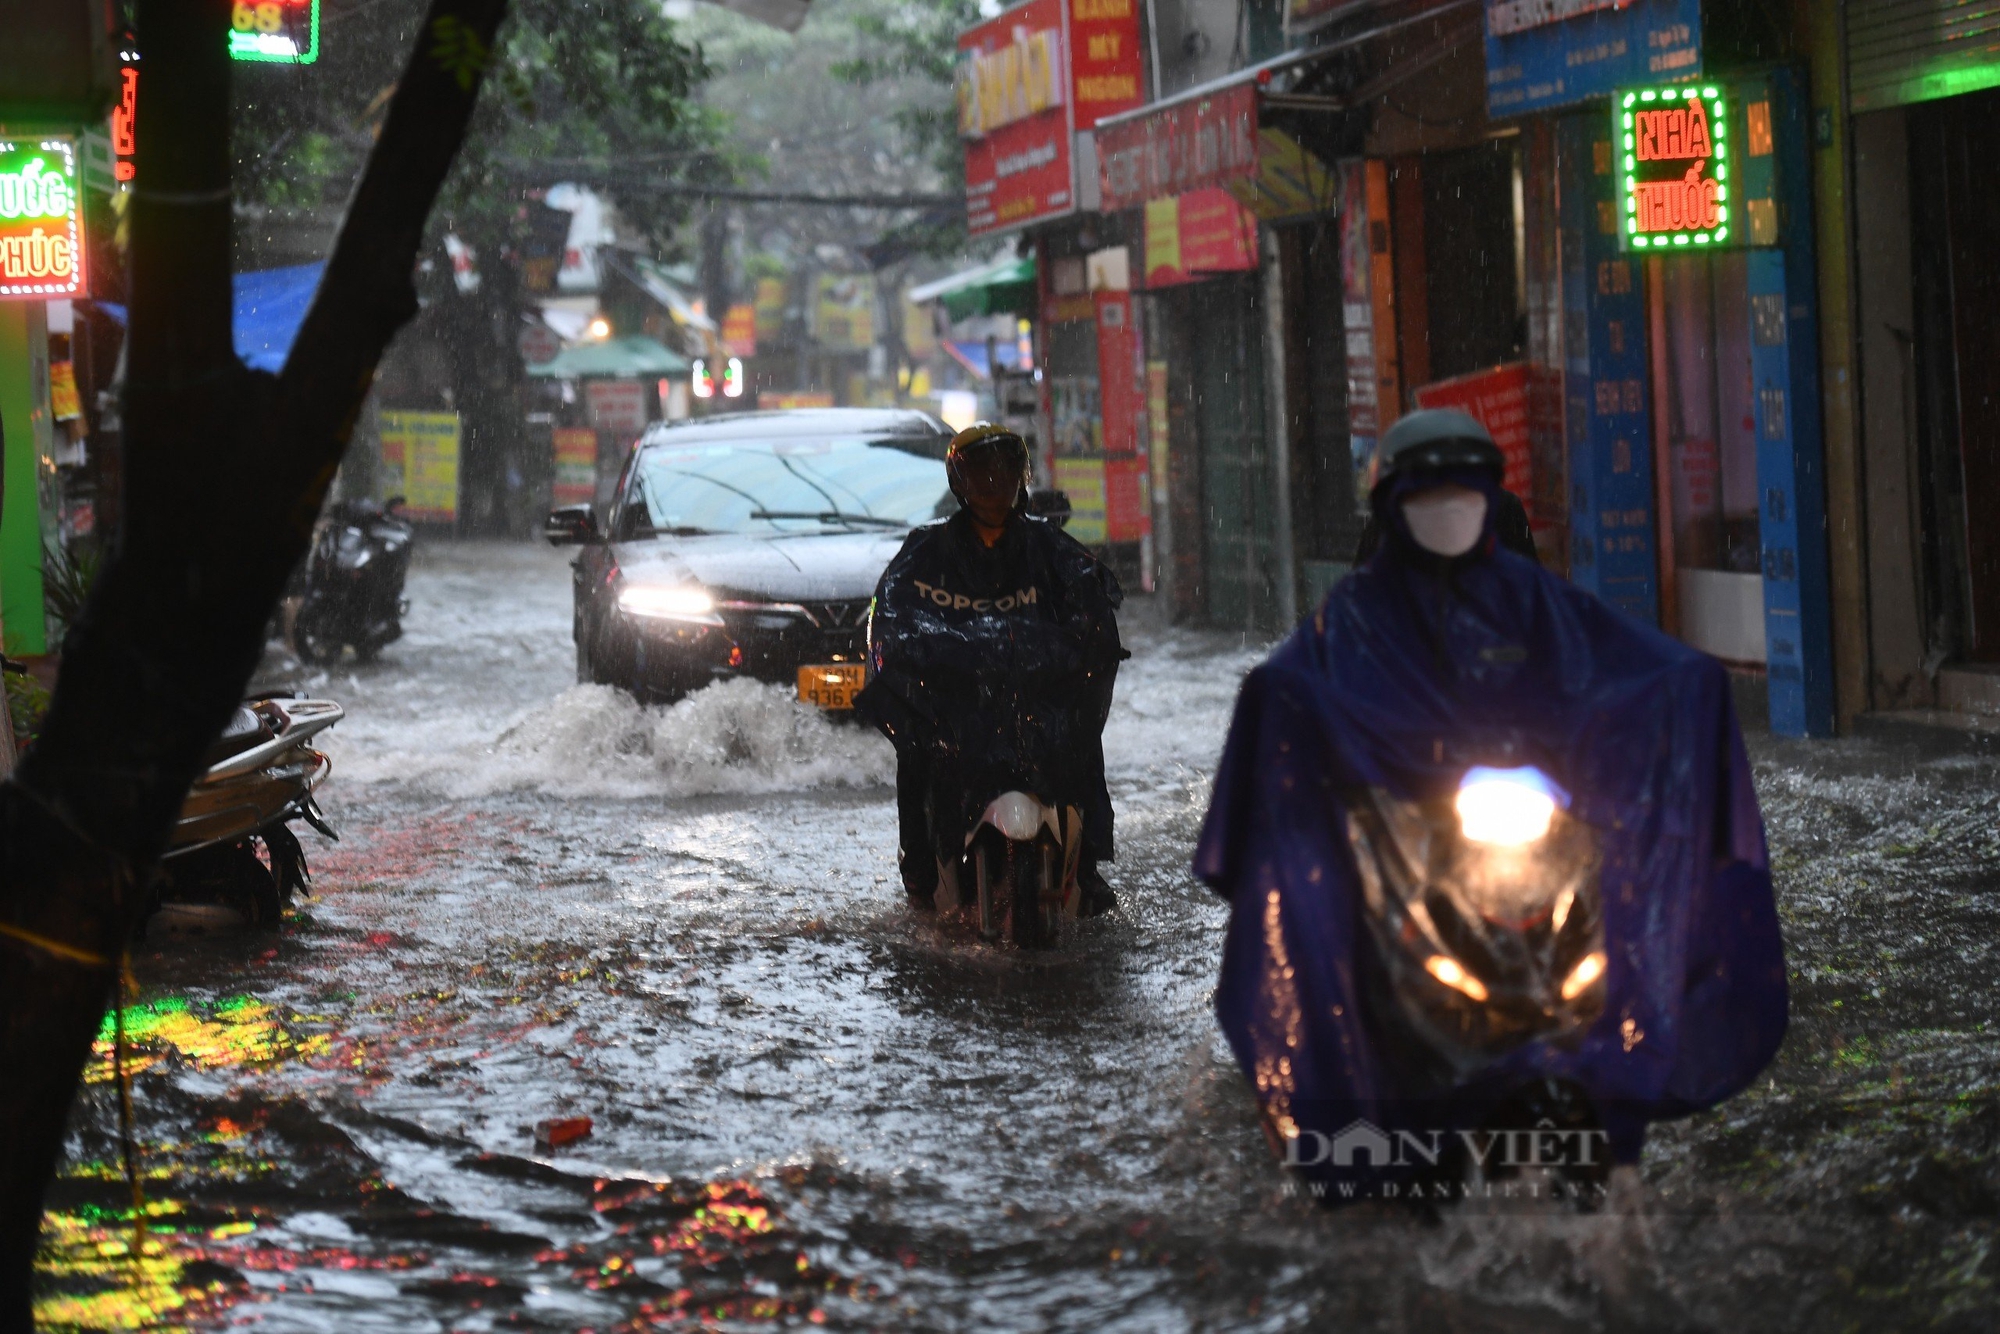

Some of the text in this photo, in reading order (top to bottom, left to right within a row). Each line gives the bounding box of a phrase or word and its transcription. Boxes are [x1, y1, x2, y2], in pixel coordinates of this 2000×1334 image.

[1635, 98, 1712, 161] NHÀ
[1632, 160, 1720, 232] THUỐC
[914, 580, 1037, 612] TOPCOM
